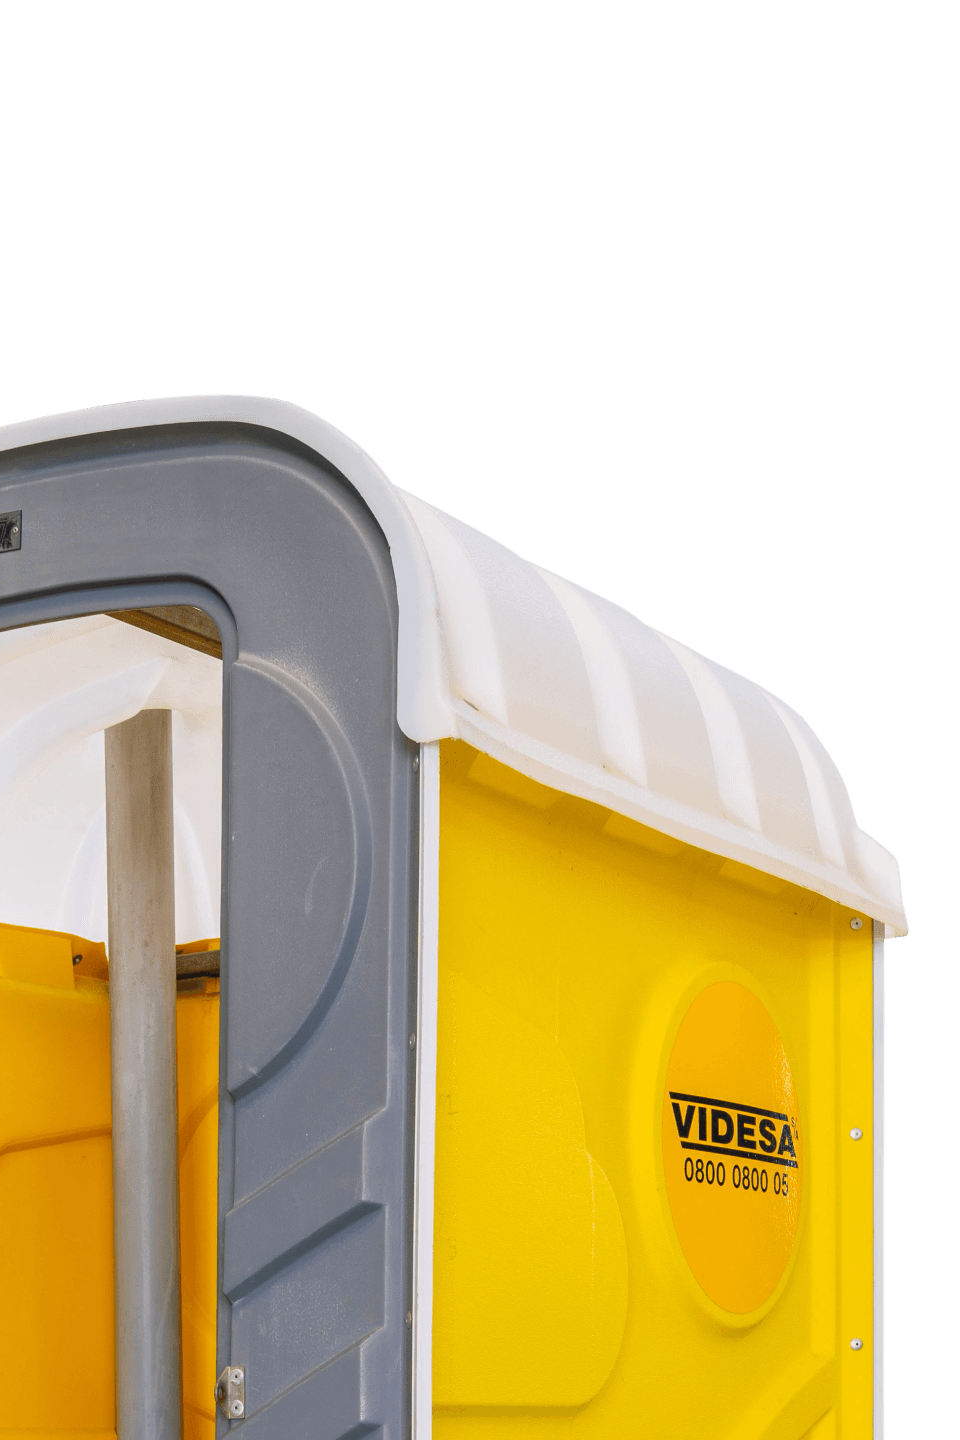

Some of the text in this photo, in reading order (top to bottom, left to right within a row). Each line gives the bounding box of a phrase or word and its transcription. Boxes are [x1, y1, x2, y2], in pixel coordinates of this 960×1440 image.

[671, 1102, 797, 1159] VIDESA
[684, 1157, 726, 1187] 0800
[732, 1164, 768, 1193] 0800
